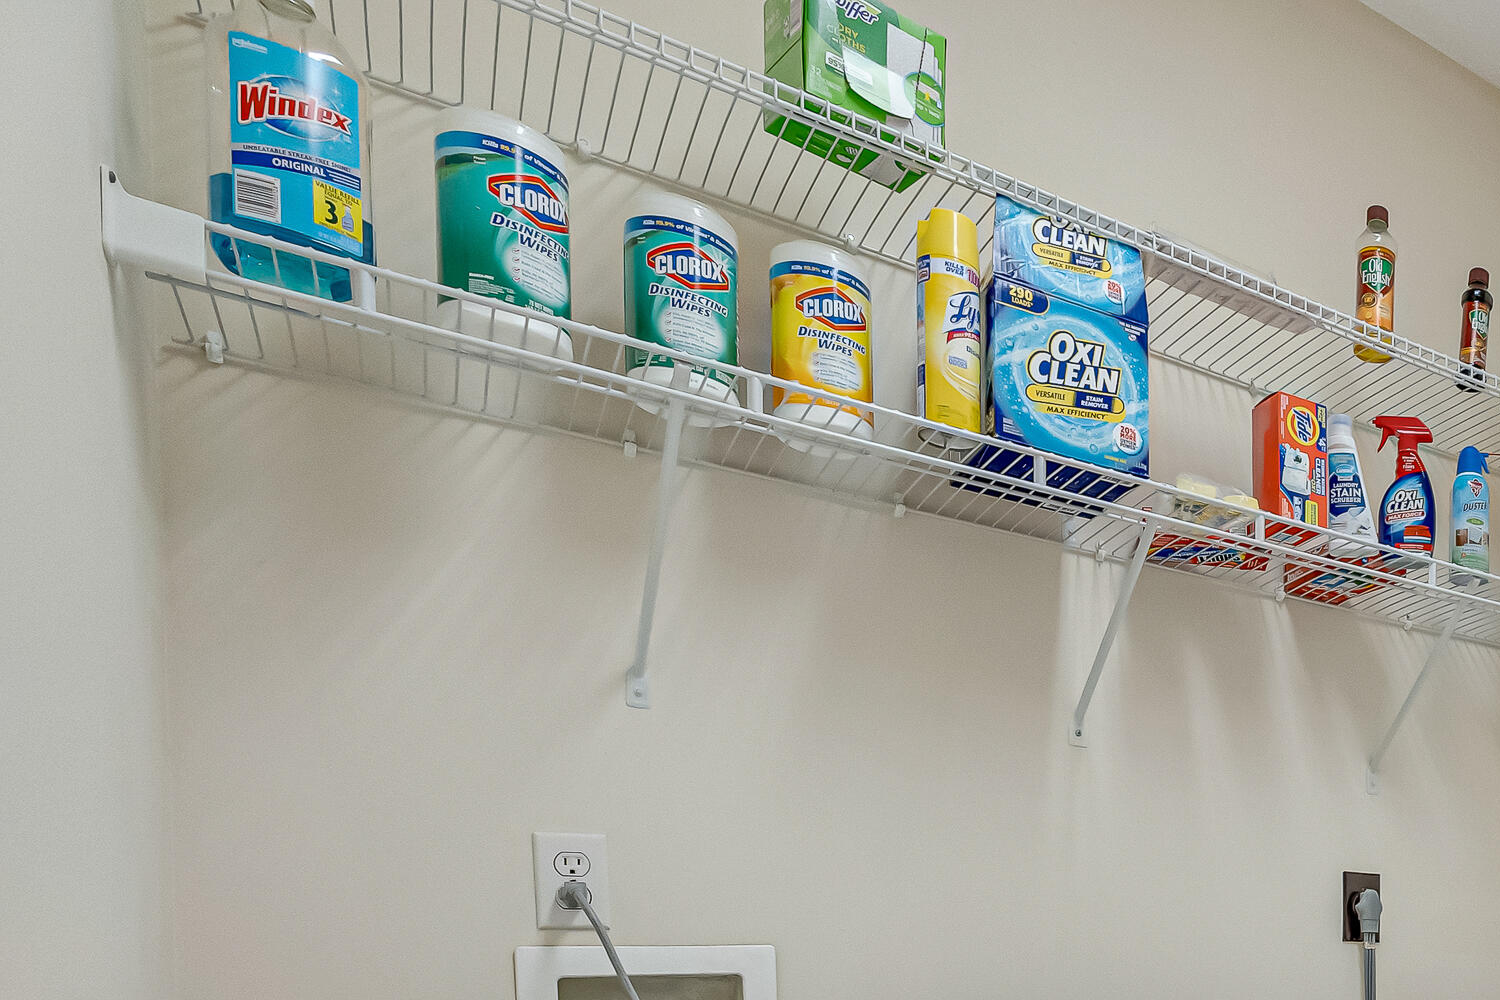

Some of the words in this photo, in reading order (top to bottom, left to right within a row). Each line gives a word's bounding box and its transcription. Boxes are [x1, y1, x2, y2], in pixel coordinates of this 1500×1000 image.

[238, 82, 352, 135] Windex
[272, 157, 327, 177] ORIGINAL
[315, 180, 337, 194] VALUE
[324, 199, 339, 225] 3
[499, 183, 568, 226] CLOROX
[1032, 217, 1106, 258] CLEAN
[518, 233, 560, 262] WIPES
[654, 254, 724, 282] CLOROX
[945, 260, 965, 272] KILLS
[946, 266, 964, 277] OVER
[1368, 258, 1383, 273] Old
[1362, 270, 1391, 287] English
[649, 283, 728, 318] DISINFECTING
[1009, 284, 1033, 301] 290
[670, 297, 712, 318] WIPES
[803, 299, 863, 325] CLOROX
[798, 327, 866, 355] DISINFECTING
[817, 339, 853, 357] WIPES
[1049, 332, 1102, 366] OXI
[1029, 351, 1120, 393] CLEAN
[1035, 389, 1066, 401] VERSATILE
[1046, 405, 1065, 415] MAX
[1080, 400, 1109, 410] REMOVER
[1292, 407, 1313, 443] Tide
[1330, 488, 1362, 498] STAIN
[1394, 489, 1417, 501] OXI
[1386, 499, 1424, 513] CLEAN
[1388, 513, 1401, 521] MAX
